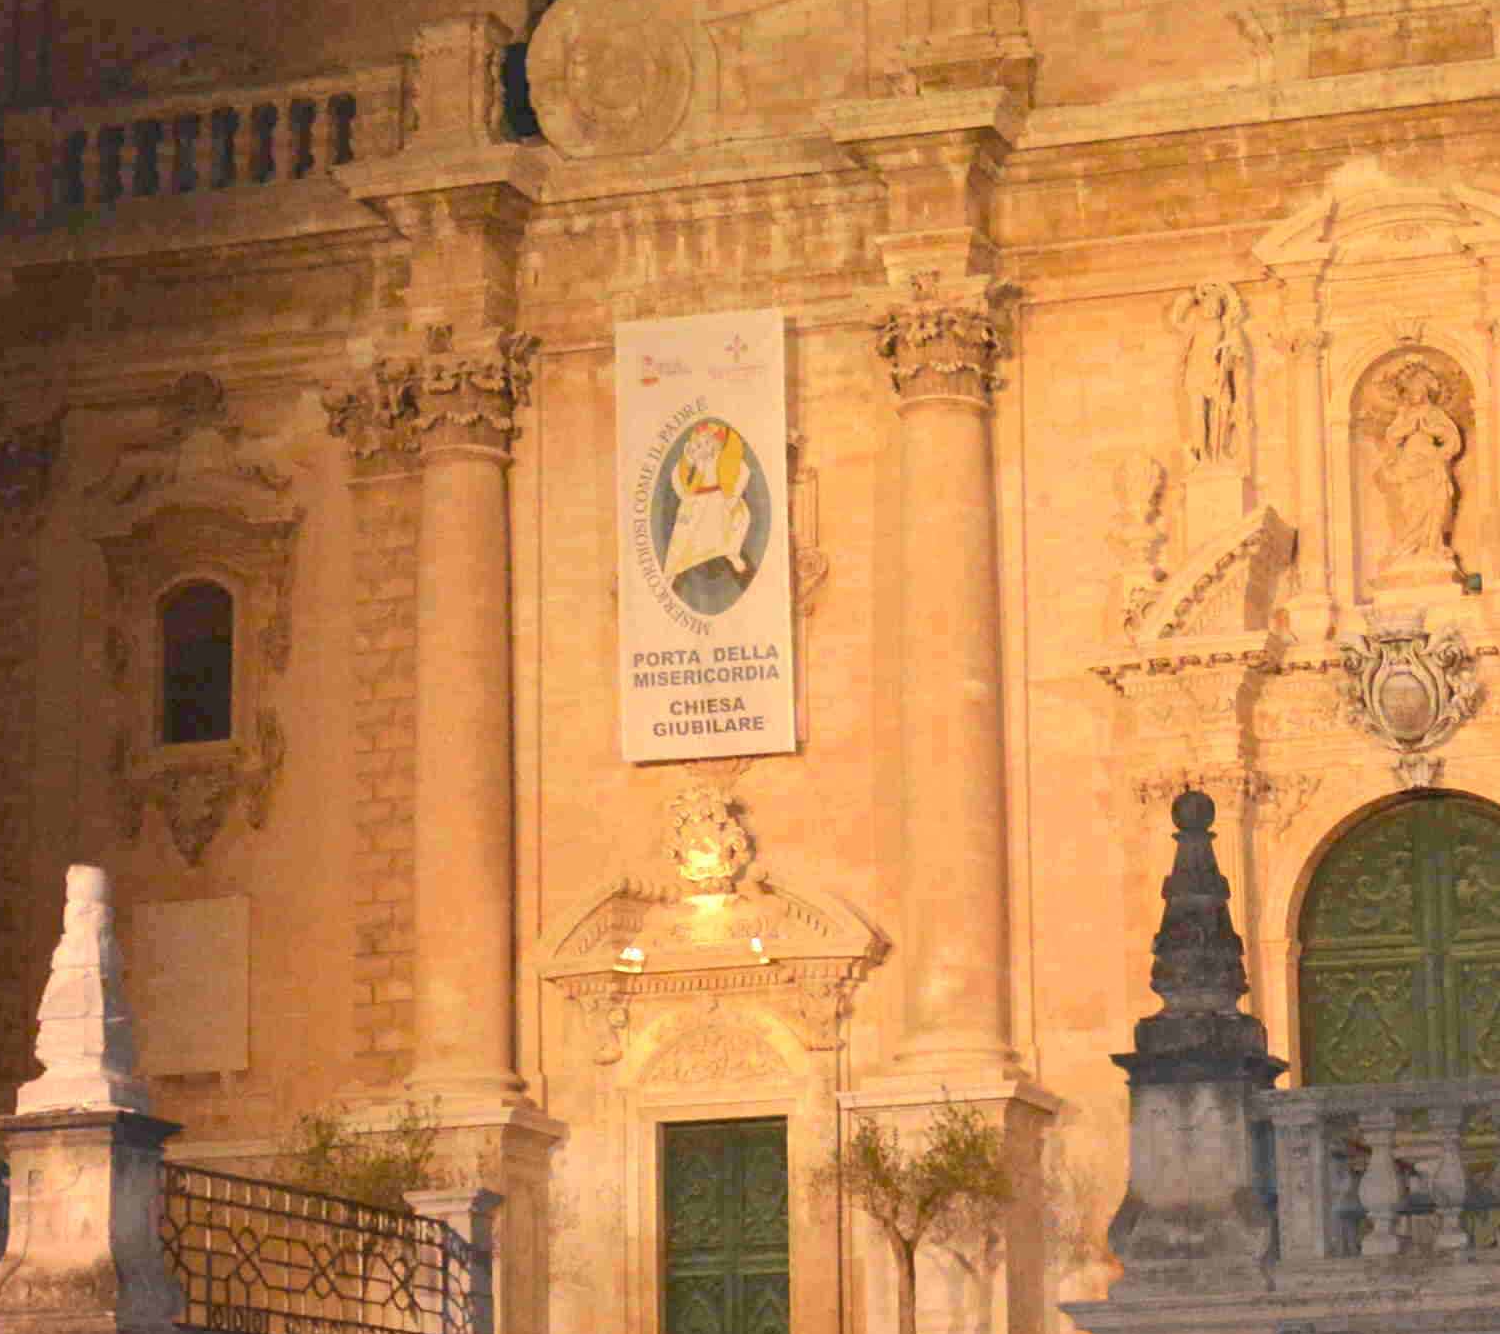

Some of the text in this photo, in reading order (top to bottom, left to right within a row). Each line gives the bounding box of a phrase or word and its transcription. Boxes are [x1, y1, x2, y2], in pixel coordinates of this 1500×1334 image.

[658, 394, 708, 443] PADRE
[633, 644, 779, 667] PORTA DELLA
[633, 664, 780, 688] MISERICORDIA
[669, 697, 746, 716] CHIESA
[652, 715, 765, 737] GIUBILARE
